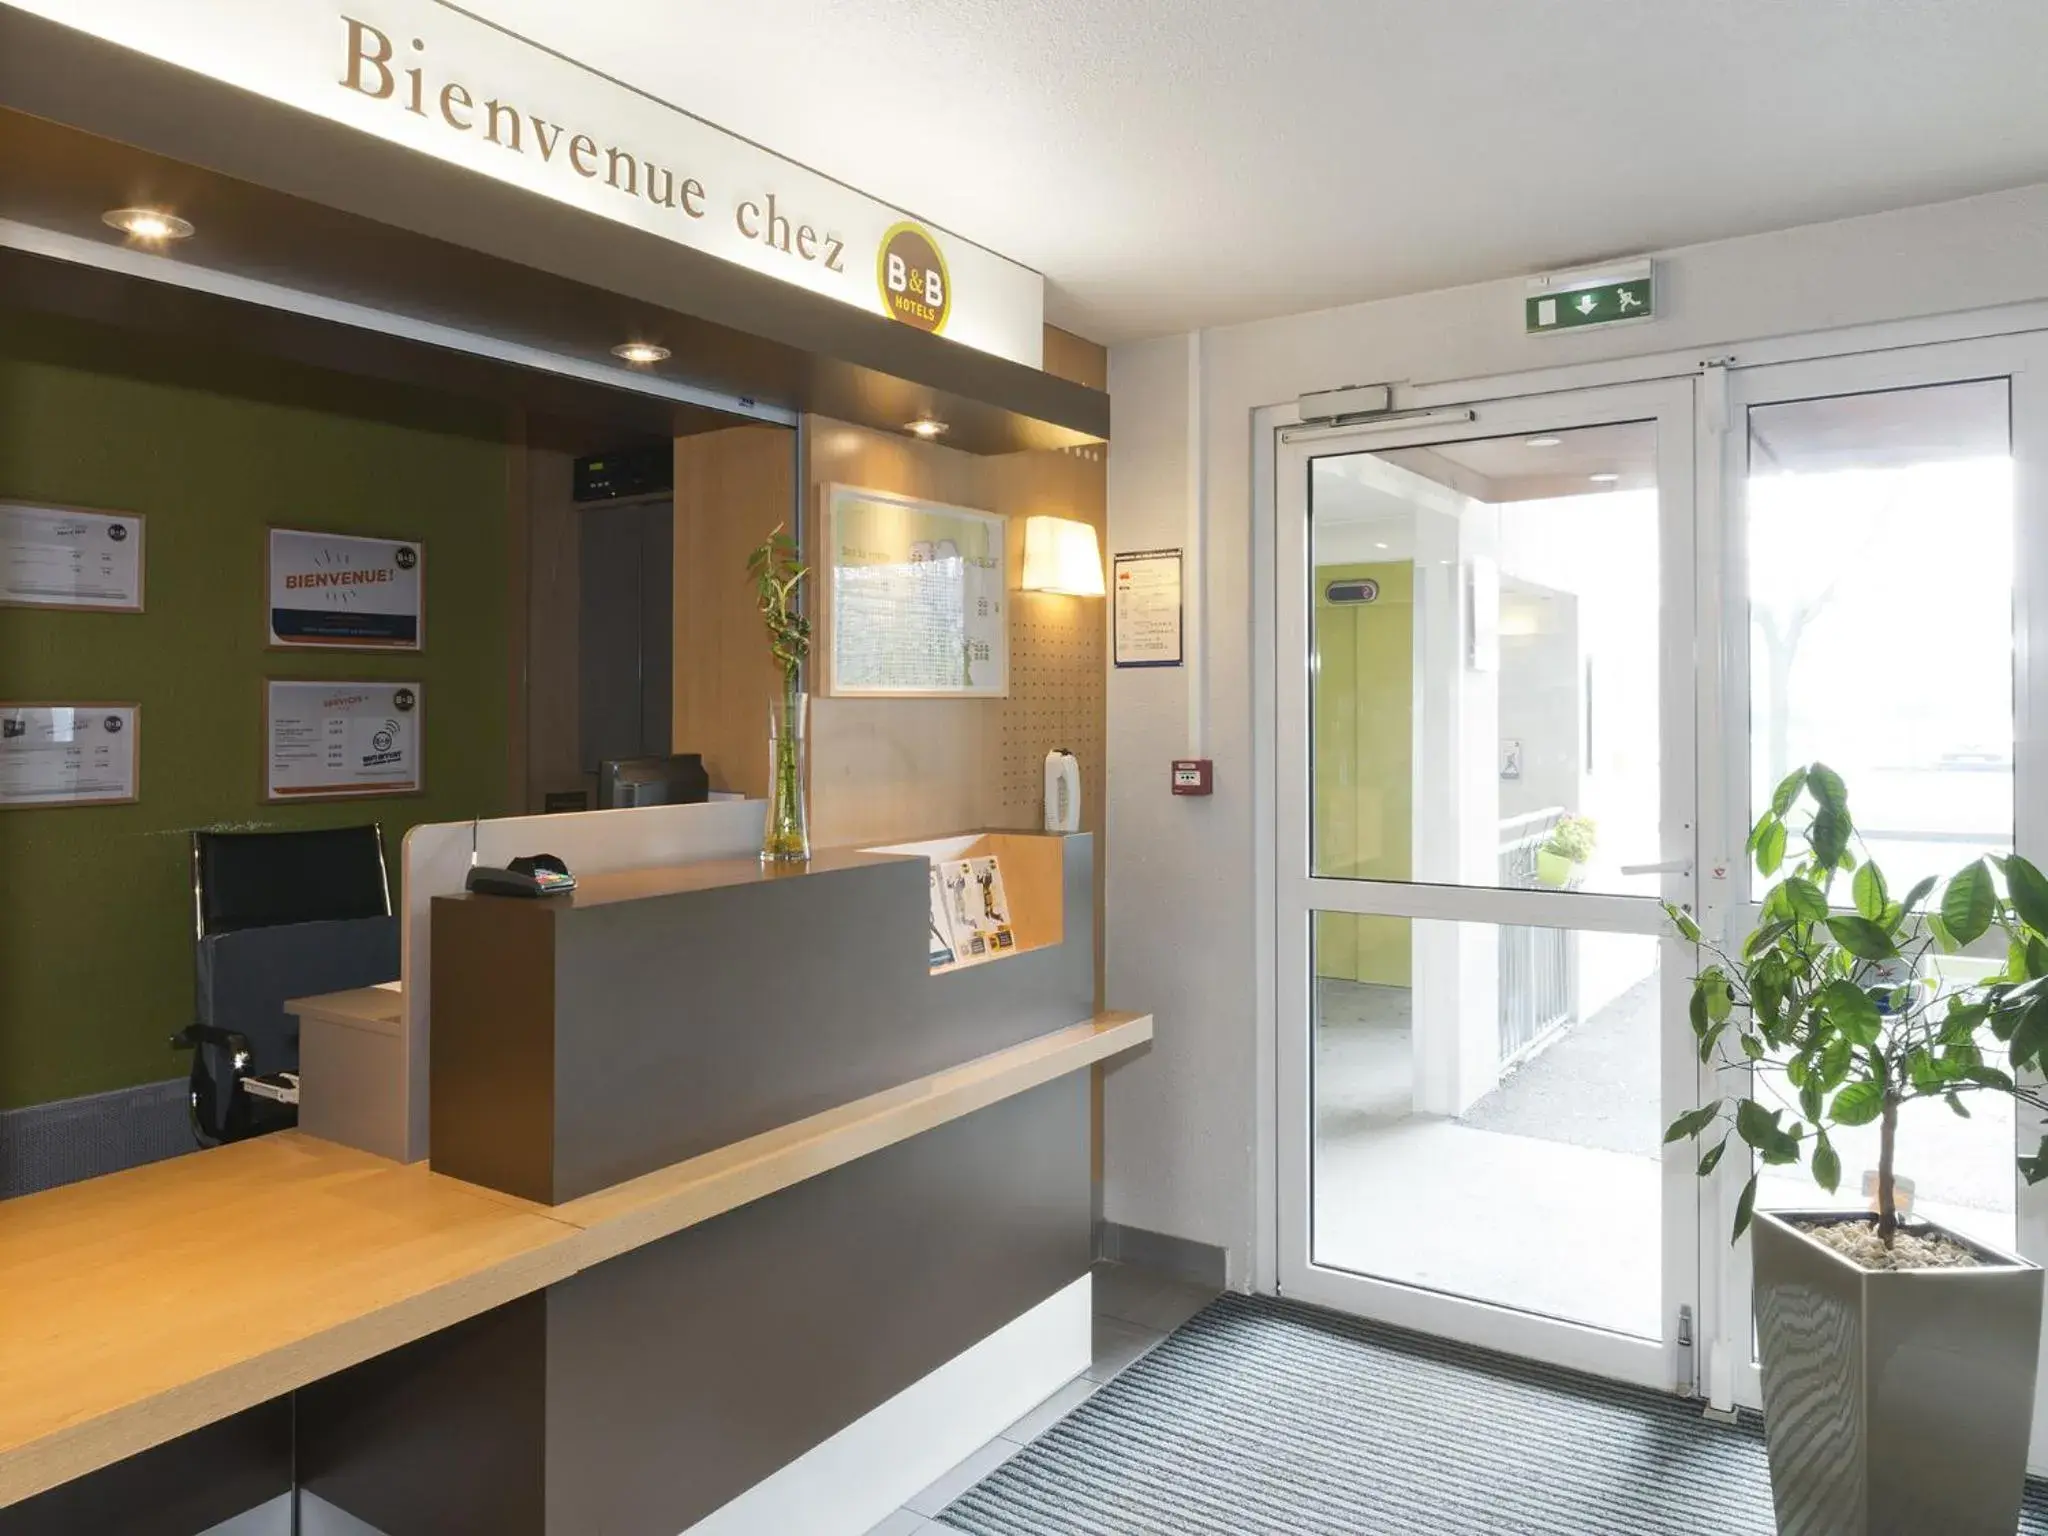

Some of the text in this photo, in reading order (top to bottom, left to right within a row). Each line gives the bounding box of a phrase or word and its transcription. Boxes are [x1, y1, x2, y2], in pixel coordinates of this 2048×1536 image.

[337, 15, 845, 273] Bienvenue chez
[888, 252, 943, 307] B&B
[895, 295, 935, 321] HOTELS
